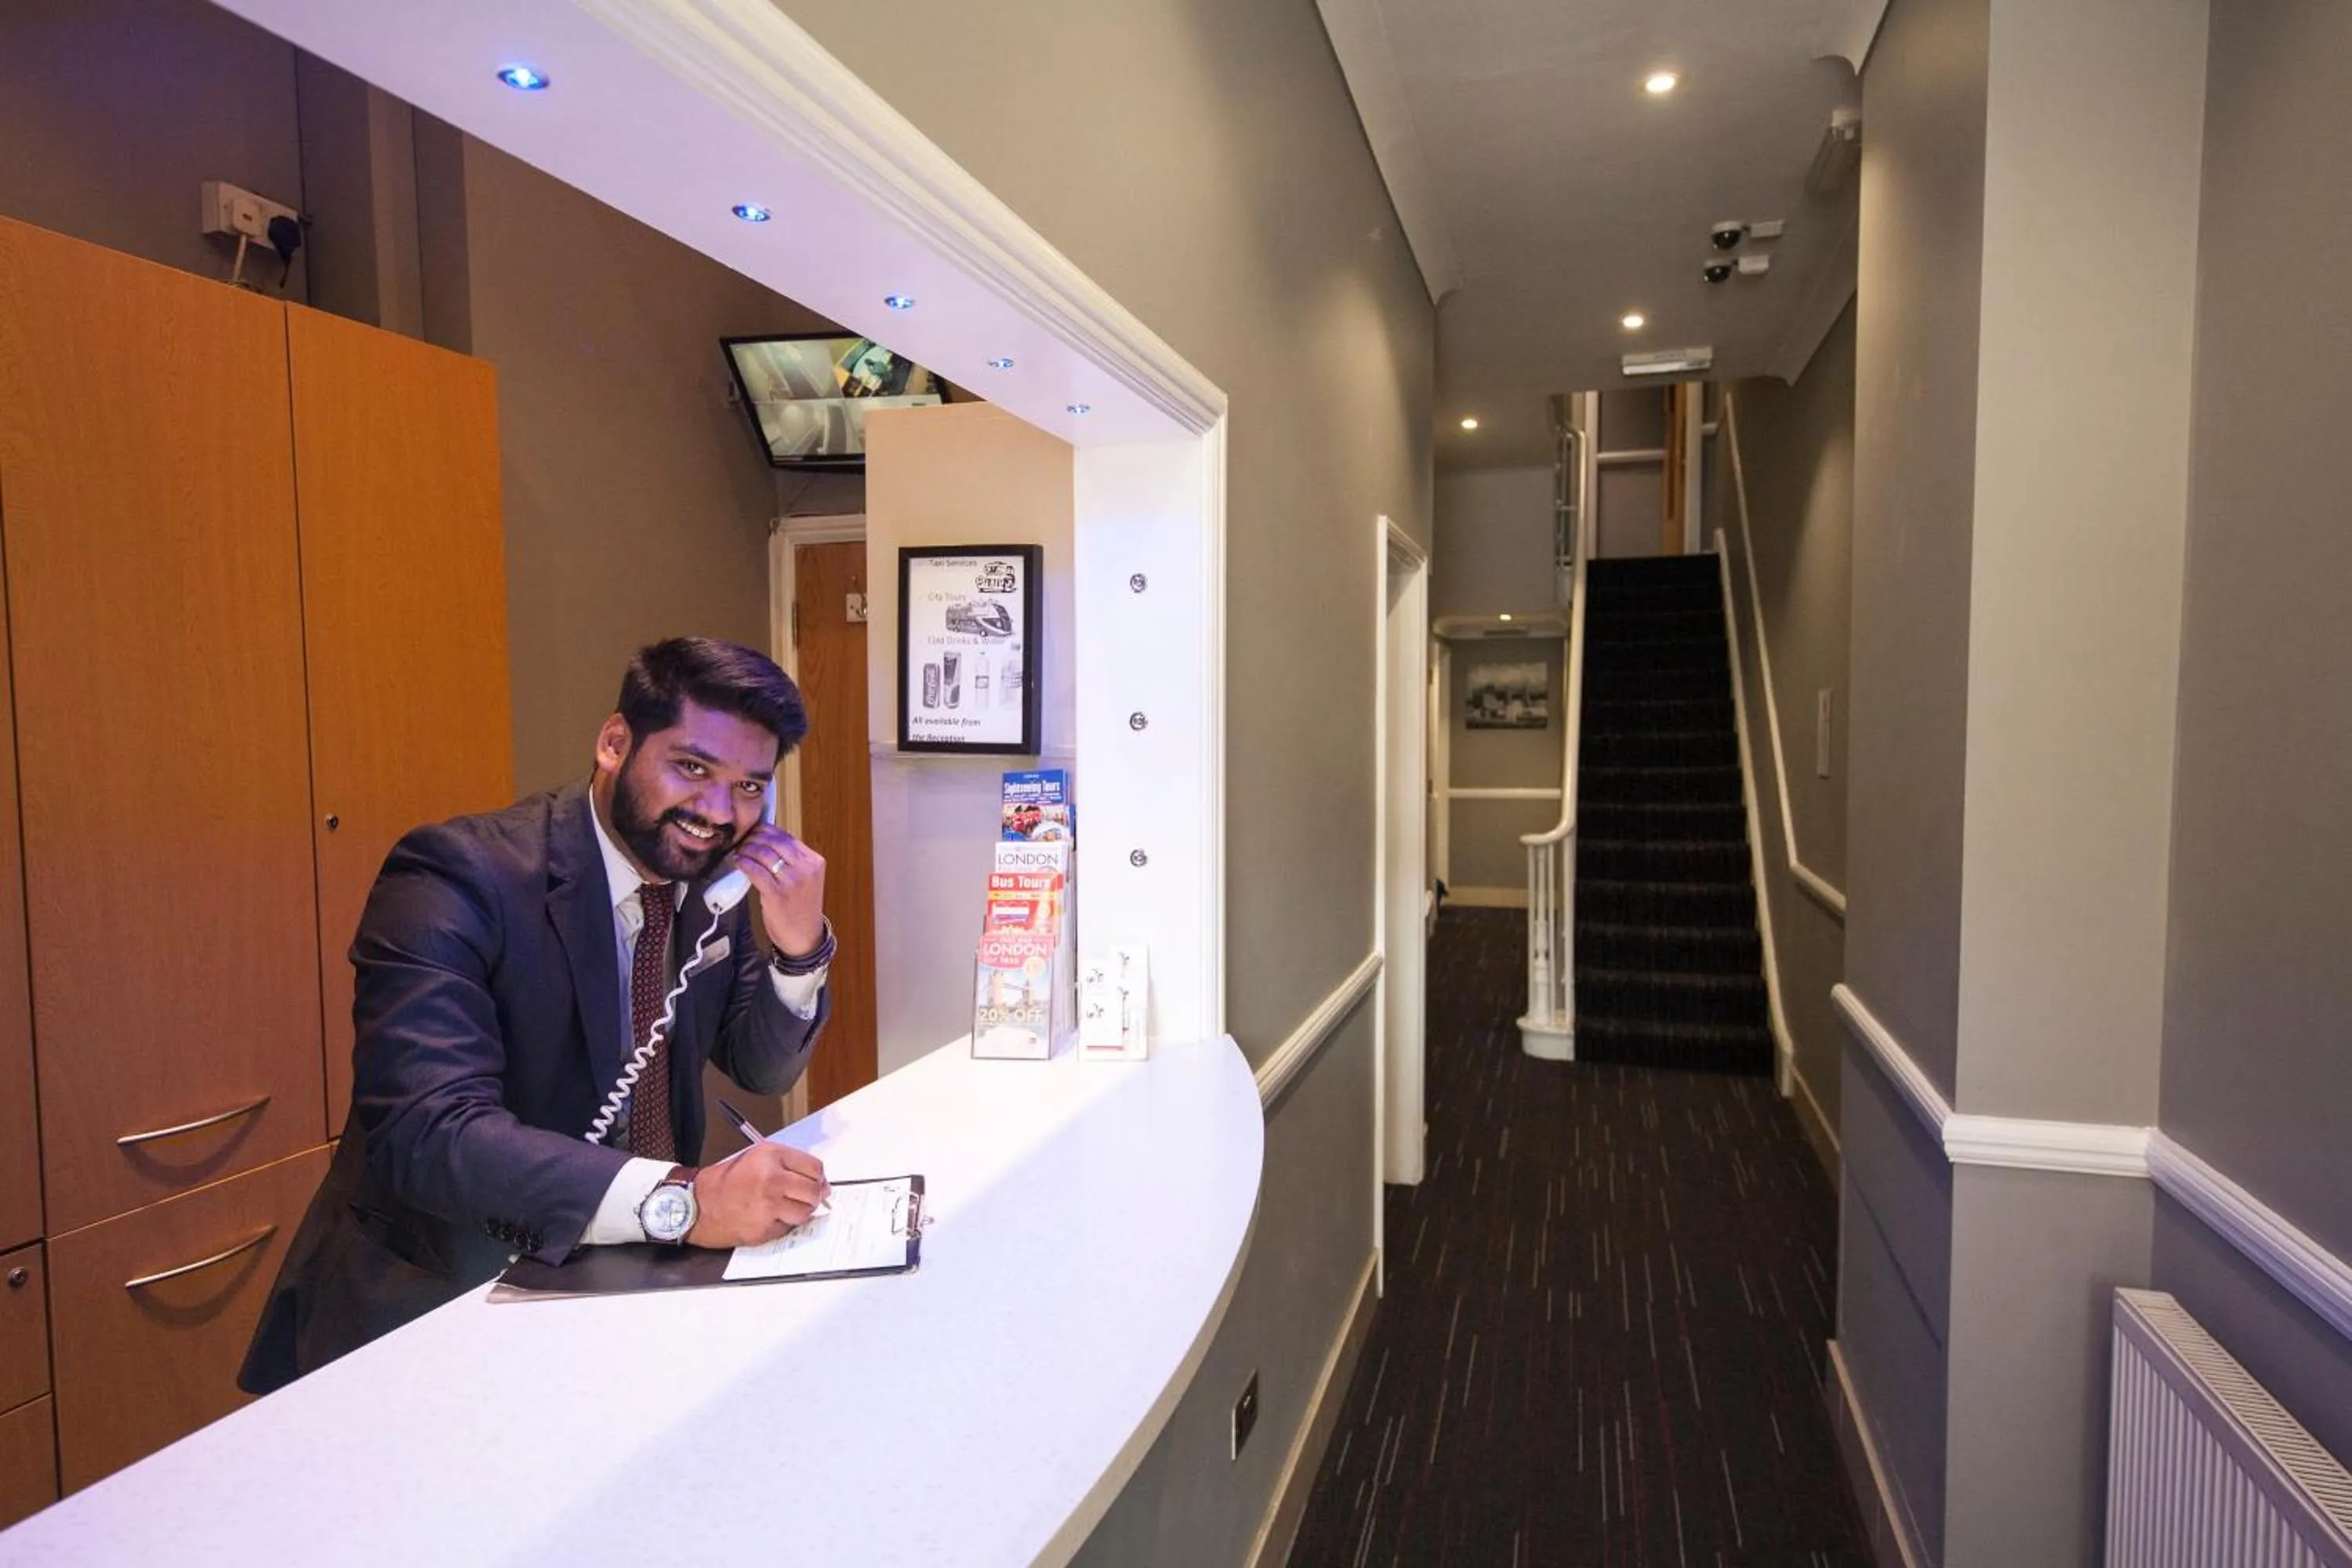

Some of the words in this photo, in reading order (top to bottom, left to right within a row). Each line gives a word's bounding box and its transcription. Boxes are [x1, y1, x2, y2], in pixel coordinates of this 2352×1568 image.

[998, 852, 1058, 866] LONDON
[991, 876, 1014, 888] Bus
[982, 942, 1047, 956] LONDON
